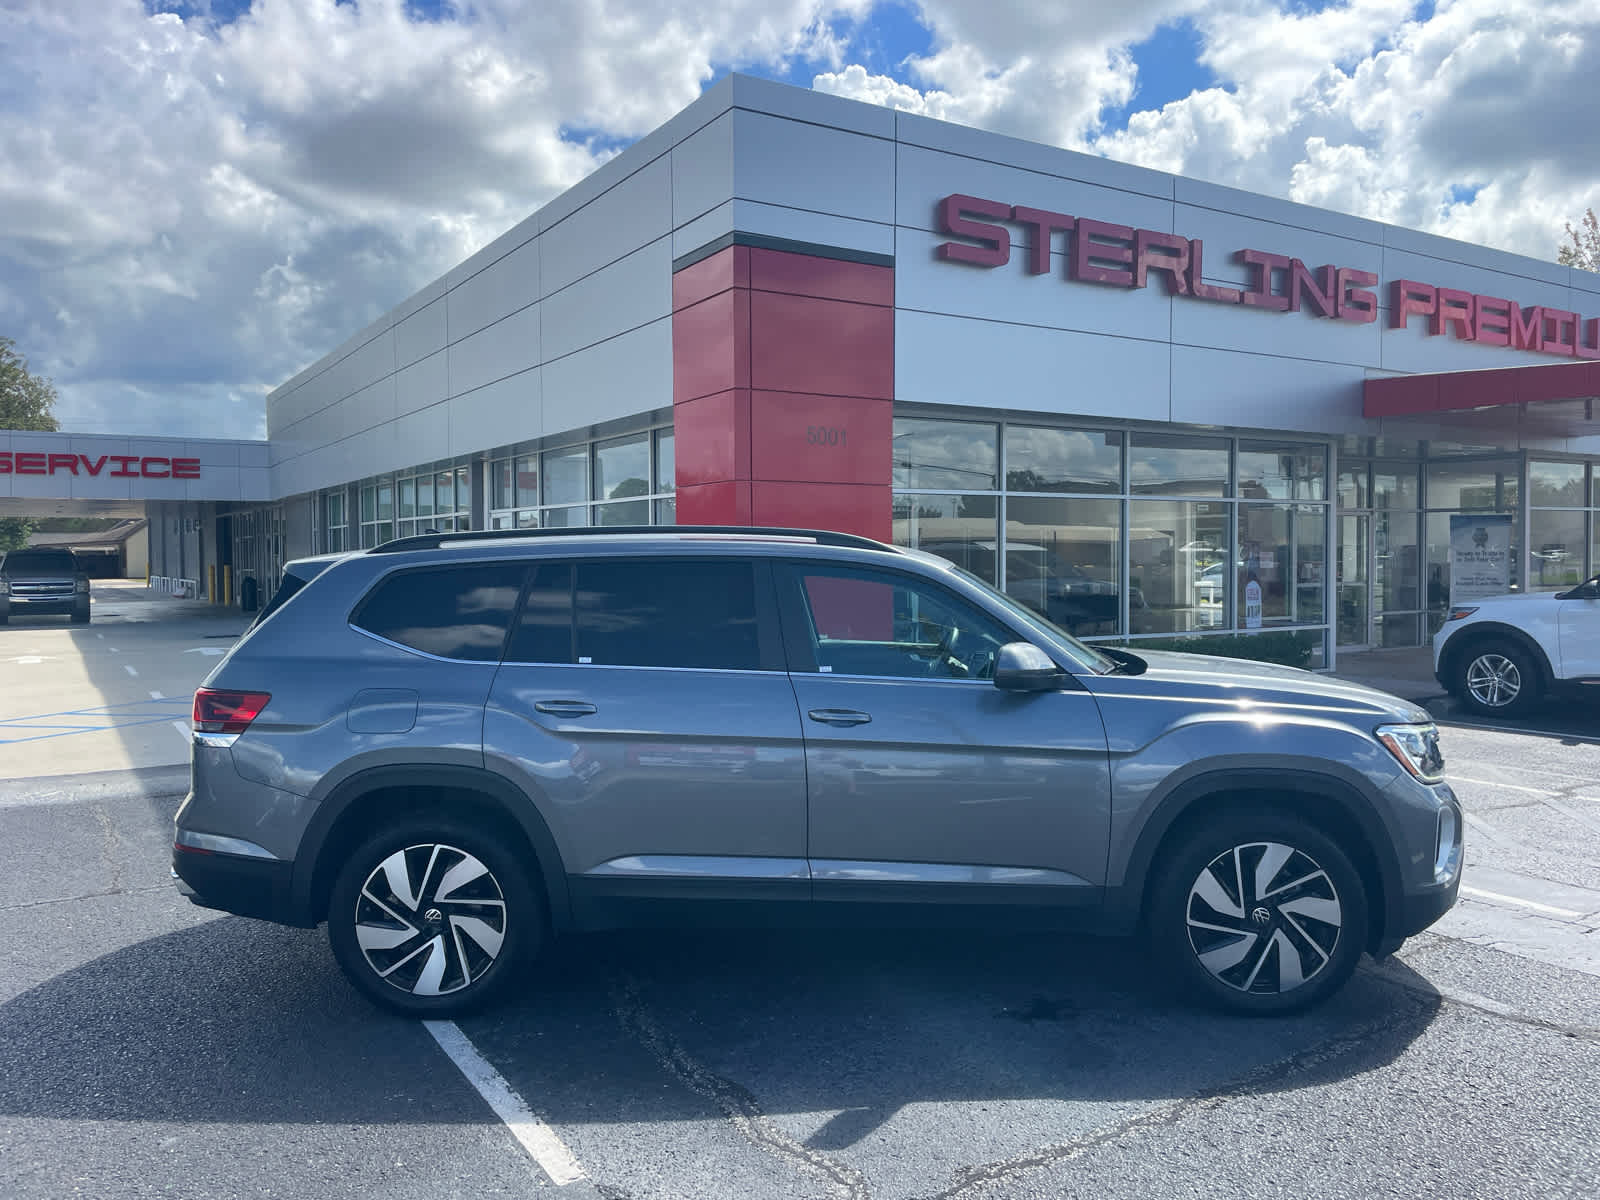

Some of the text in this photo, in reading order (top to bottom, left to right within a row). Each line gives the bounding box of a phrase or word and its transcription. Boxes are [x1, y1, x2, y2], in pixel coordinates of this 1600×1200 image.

[936, 193, 1600, 360] STERLING PREMIU
[806, 425, 847, 447] 5001
